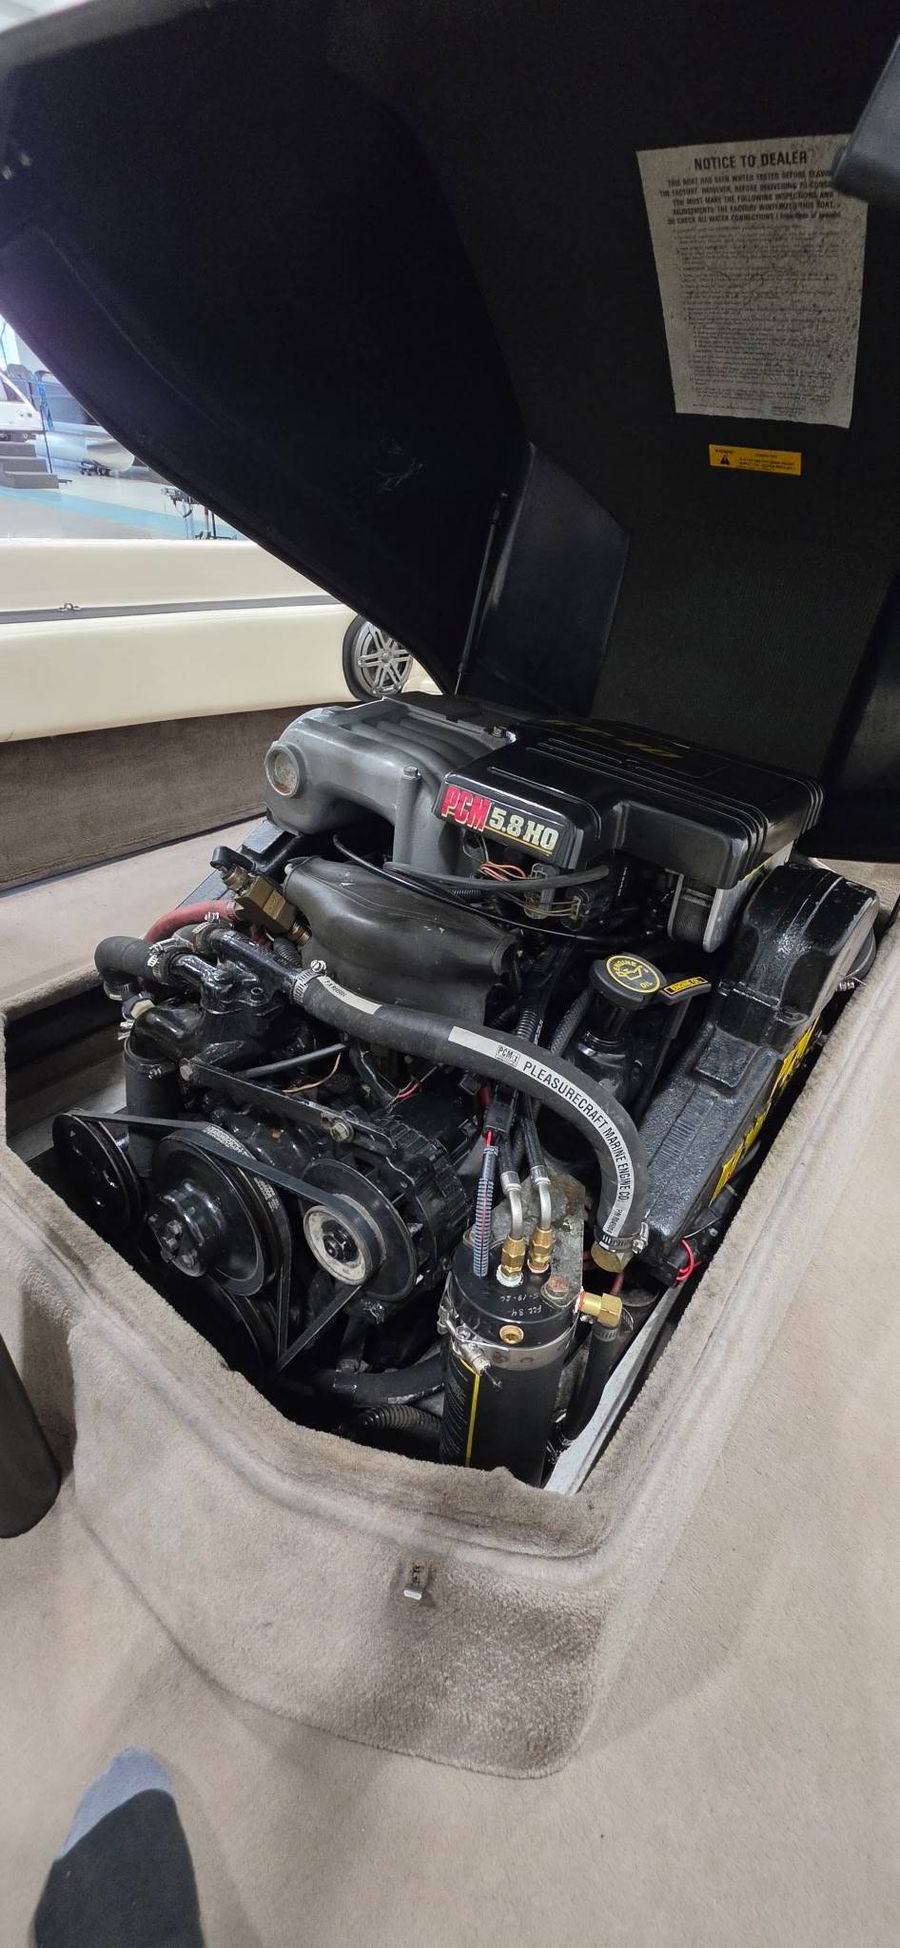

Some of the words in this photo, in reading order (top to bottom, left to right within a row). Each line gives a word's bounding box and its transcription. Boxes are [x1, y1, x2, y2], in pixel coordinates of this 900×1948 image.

[694, 155, 736, 170] NOTICE
[740, 153, 756, 167] TO
[761, 150, 807, 166] DEALER
[732, 174, 754, 182] WATER
[756, 172, 779, 180] TESTED
[782, 170, 806, 179] BEFORE
[737, 194, 773, 202] FOLLOWING
[731, 213, 774, 222] CONNECTIONS
[441, 784, 493, 832] PCM
[488, 806, 525, 837] 5.8
[522, 820, 559, 851] HO
[523, 1061, 608, 1129] PLEASURECRAFT
[602, 1127, 627, 1162] MARINE
[617, 1162, 631, 1190] ENGINE
